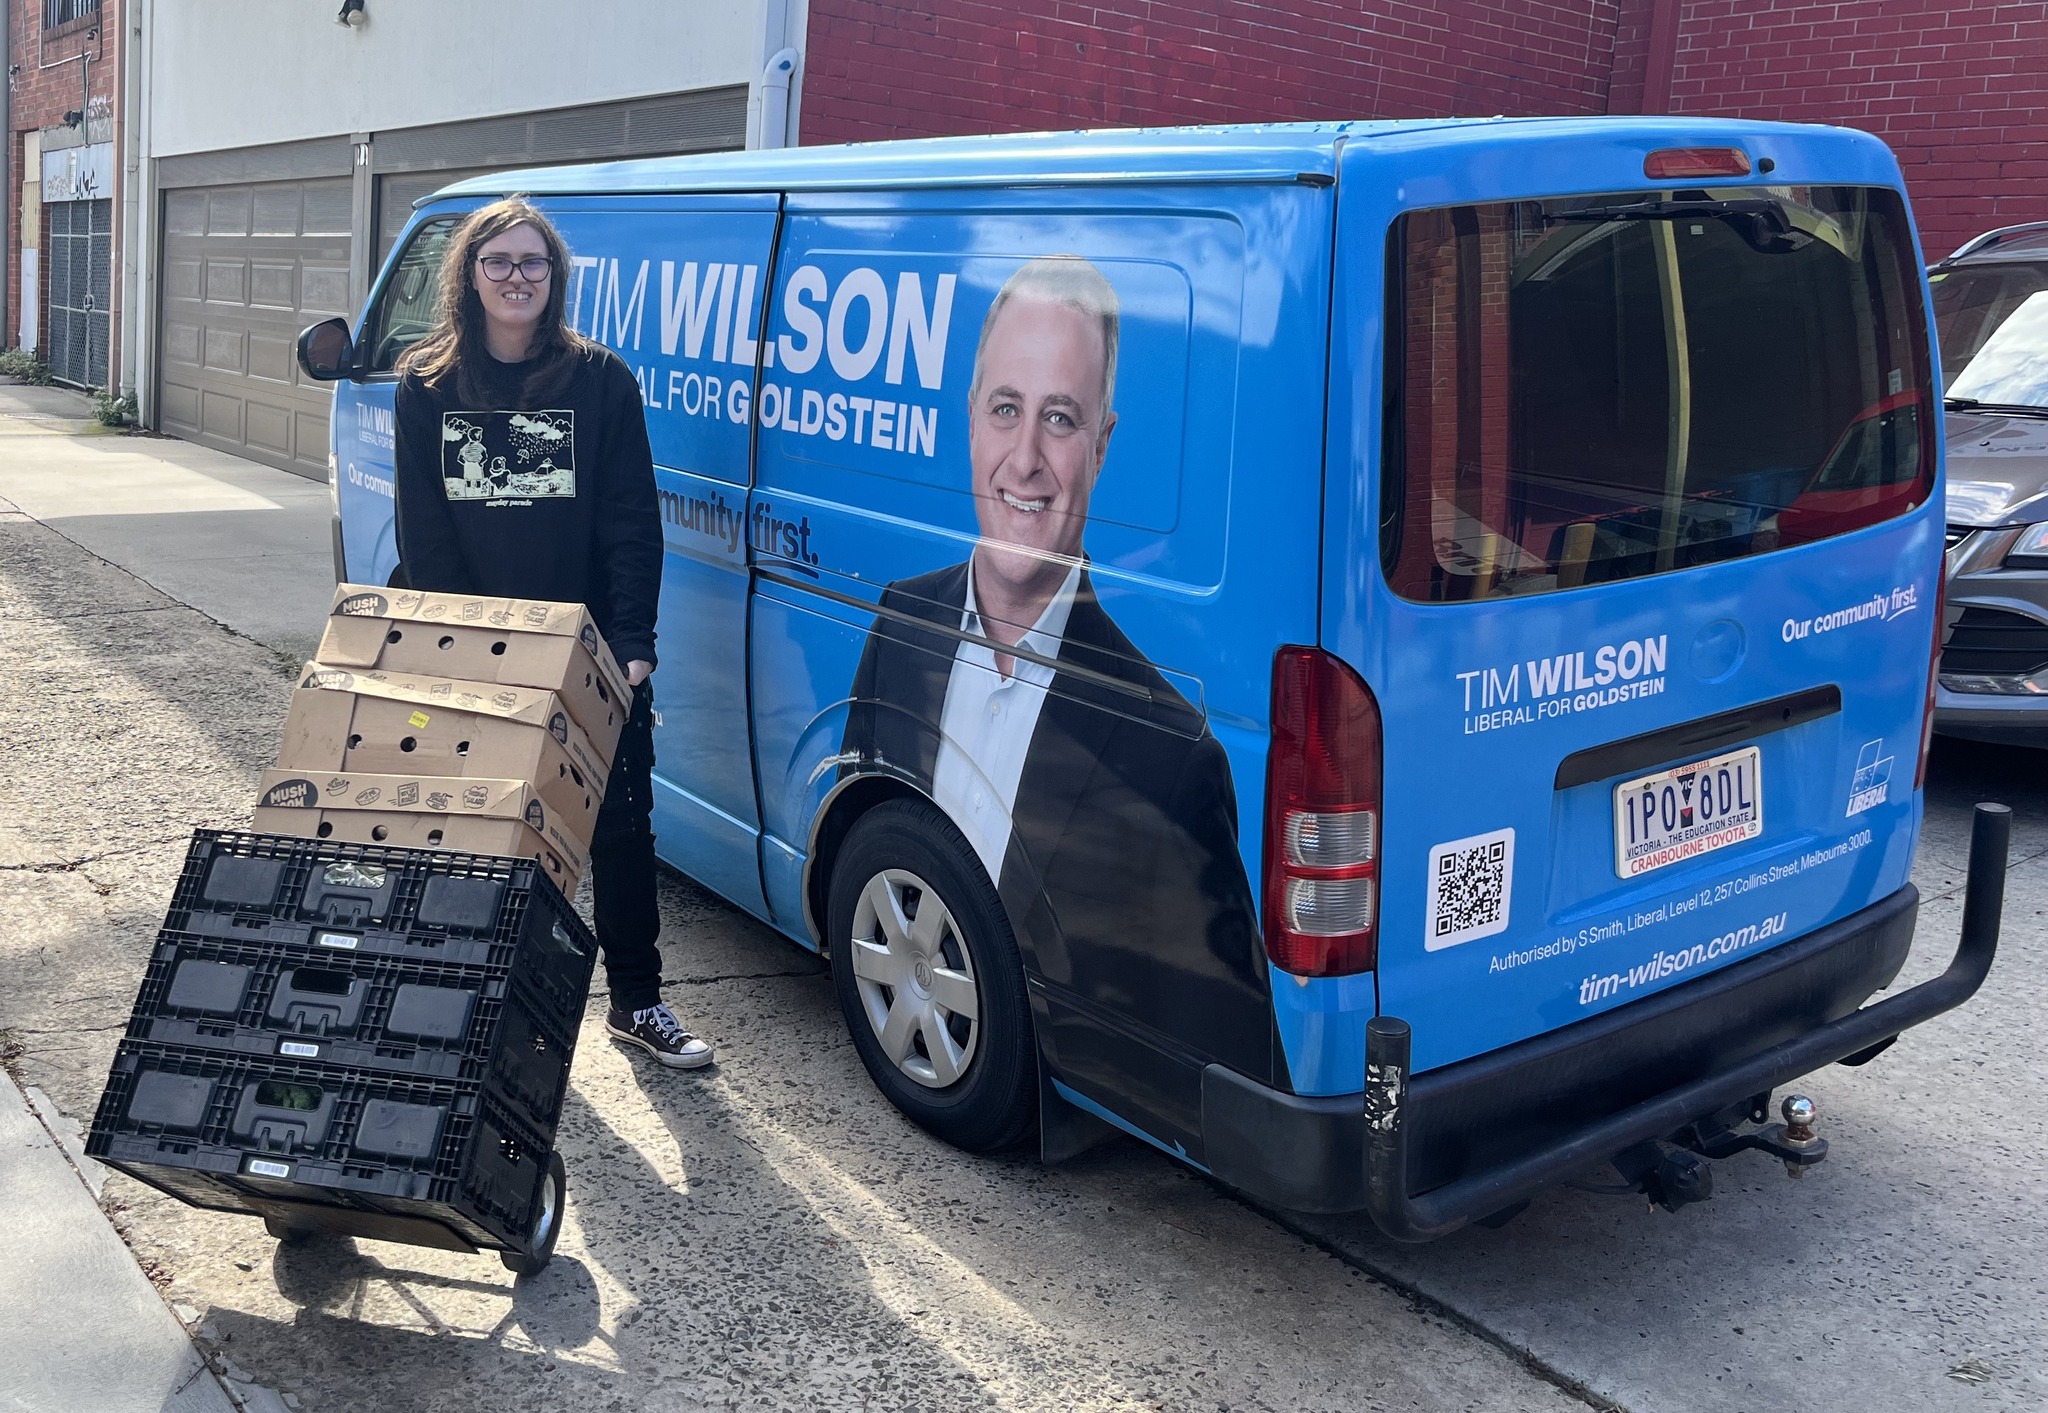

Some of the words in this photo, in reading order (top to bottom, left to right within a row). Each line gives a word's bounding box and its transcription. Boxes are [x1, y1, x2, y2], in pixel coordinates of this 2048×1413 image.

[571, 256, 650, 351] TIM
[659, 260, 958, 391] WILSON
[356, 402, 374, 431] TIM
[374, 406, 395, 436] WIL
[667, 370, 722, 420] FOR
[727, 379, 939, 458] GOLDSTEIN
[348, 462, 364, 487] Our
[364, 473, 395, 499] commu
[658, 488, 743, 554] munity
[752, 502, 819, 566] first.
[343, 597, 378, 613] MUSH
[1782, 618, 1812, 643] Our
[1814, 594, 1889, 634] community
[1891, 584, 1917, 610] first.
[1456, 663, 1520, 712] TIM
[1526, 634, 1668, 699] WILSON
[1464, 705, 1535, 735] LIBERAL
[1537, 698, 1571, 721] FOR
[1573, 676, 1666, 712] GOLDSTEIN
[270, 783, 307, 804] MUSH
[1845, 783, 1888, 818] LIBERAL
[1626, 837, 1661, 858] VICTORIA
[1668, 832, 1683, 845] THE
[1685, 818, 1726, 839] EDUCATION
[1727, 811, 1749, 826] STATE
[1631, 838, 1704, 874] CRANBOURNE
[1707, 826, 1746, 848] TOYOTA
[1489, 936, 1560, 974] Authorised
[1562, 936, 1578, 954] by
[1578, 930, 1588, 947] S
[1589, 920, 1626, 944] Smith,
[1627, 903, 1668, 932] Liberal,
[1669, 893, 1698, 917] Level
[1699, 889, 1713, 907] 12,
[1714, 881, 1734, 903] 257
[1734, 871, 1768, 895] Collins
[1769, 859, 1799, 883] Street,
[1801, 841, 1847, 871] Melbourne
[1848, 828, 1872, 851] 3000.
[1579, 911, 1787, 1005] tim-wilson.com.au
